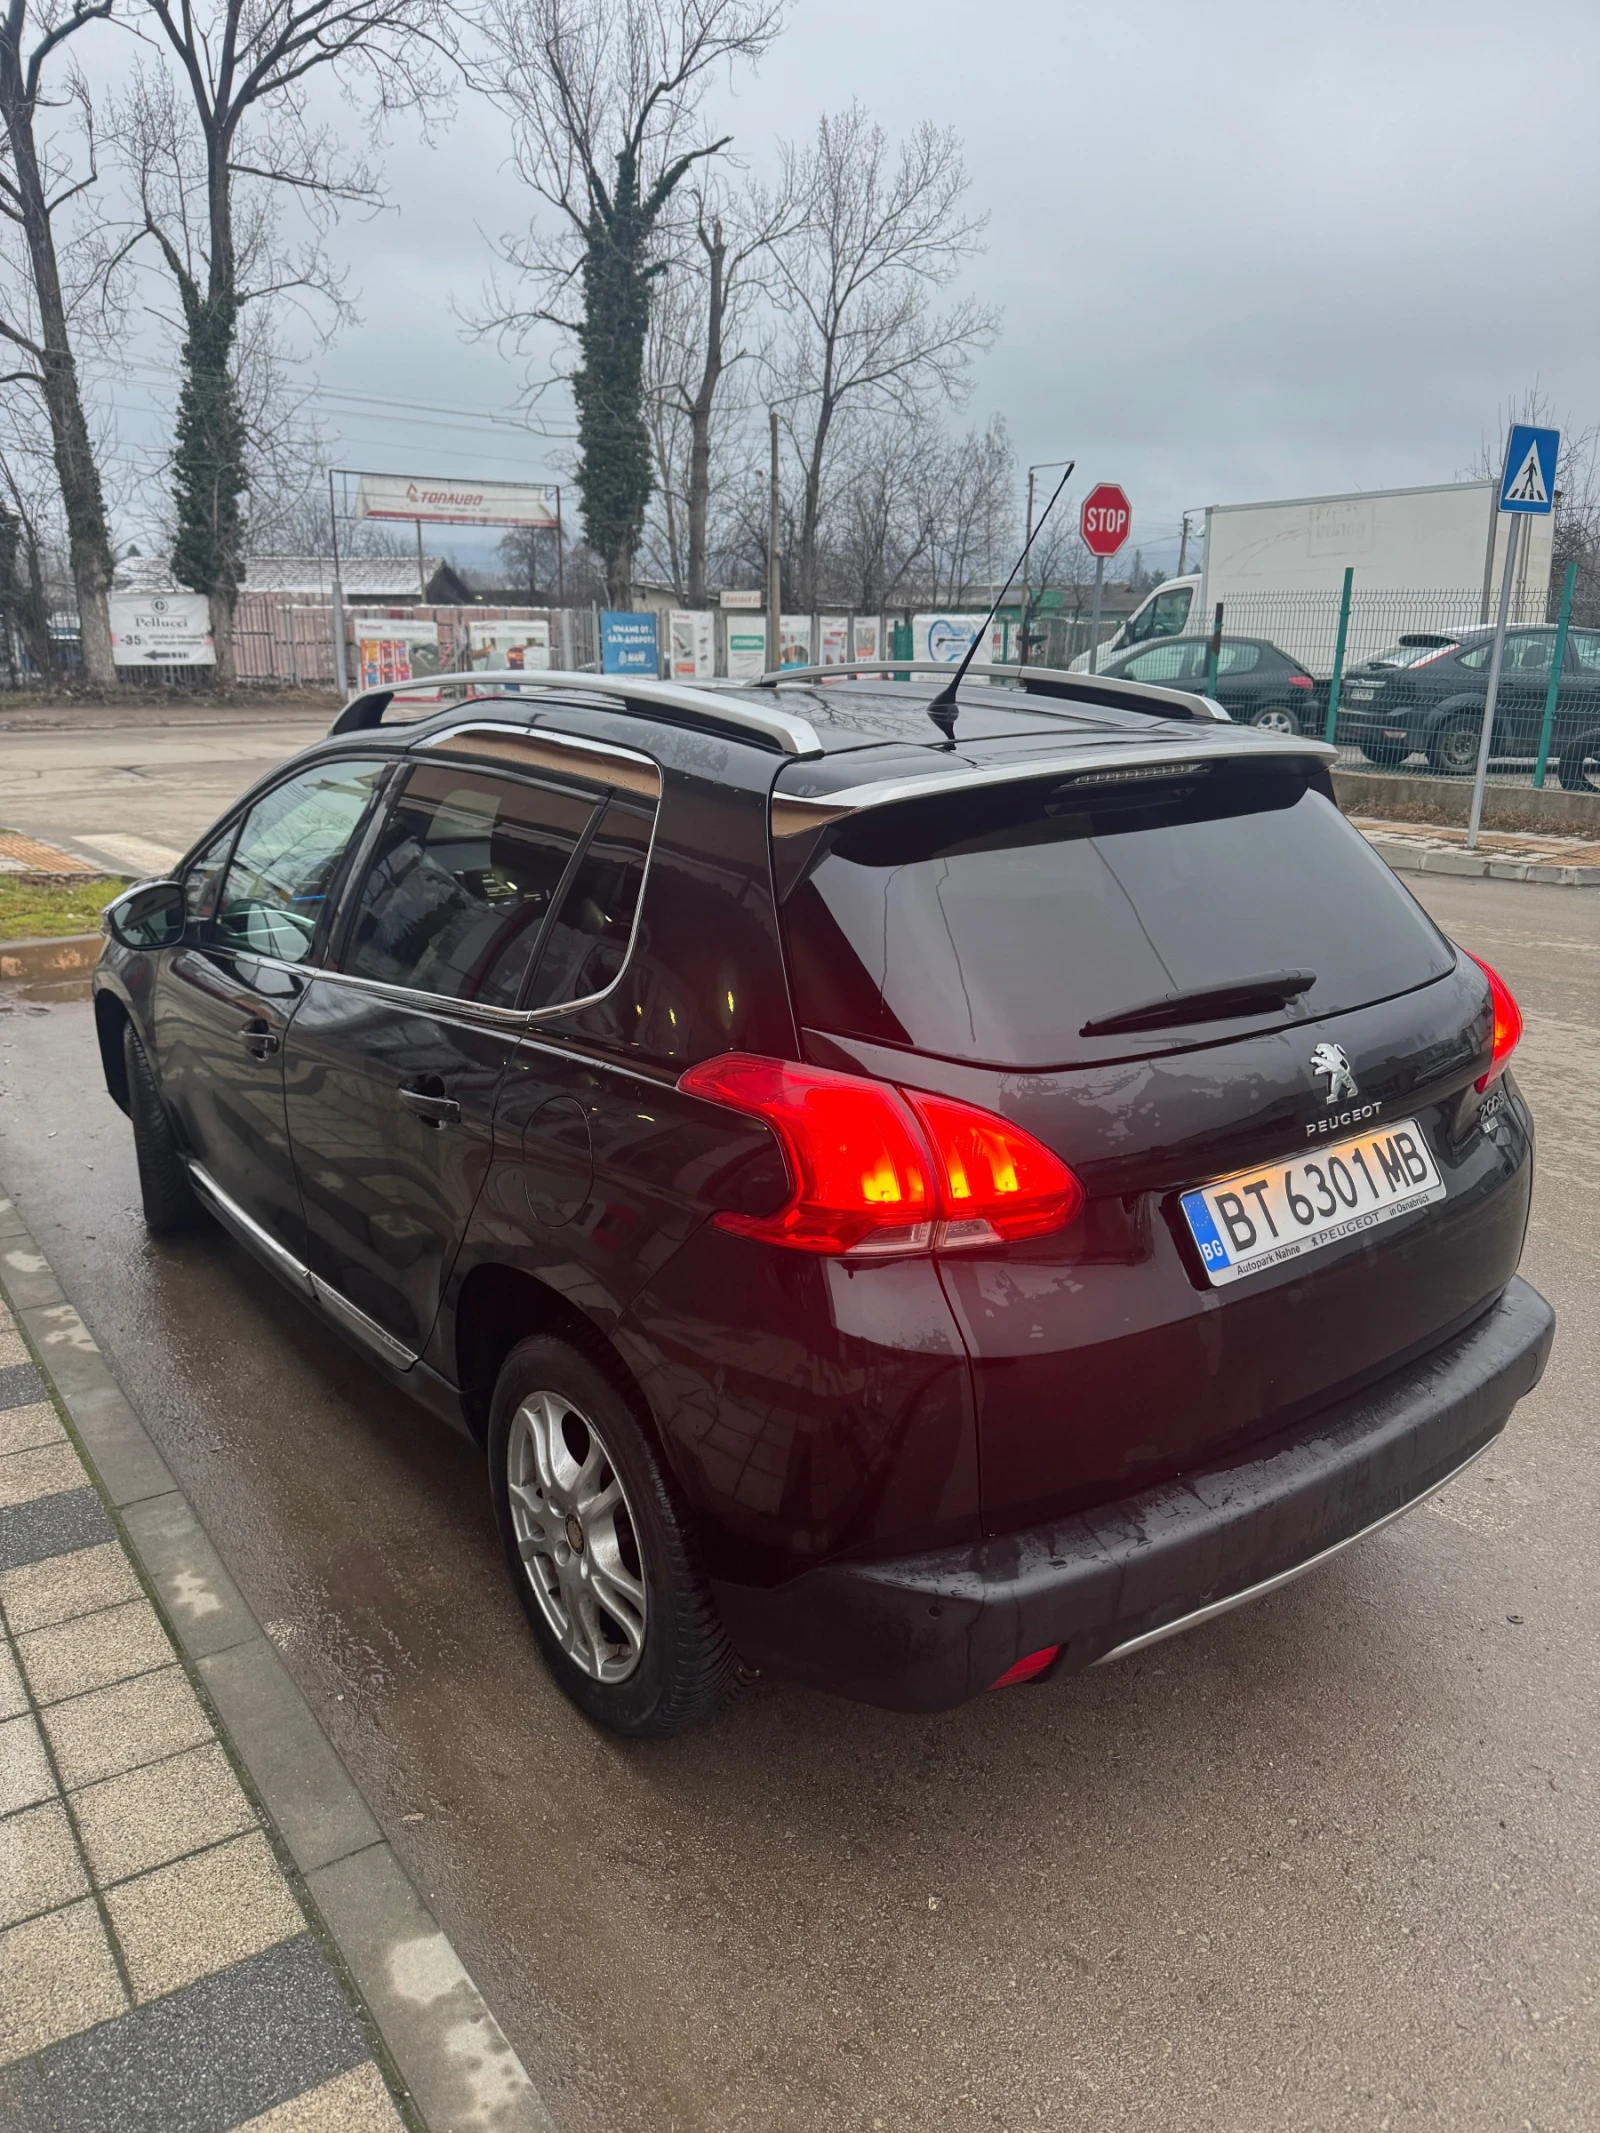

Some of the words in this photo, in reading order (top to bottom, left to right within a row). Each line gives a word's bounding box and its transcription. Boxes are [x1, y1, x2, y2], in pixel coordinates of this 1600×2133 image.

[1087, 507, 1126, 533] STOP
[136, 617, 188, 628] Pellucci
[1306, 1101, 1382, 1137] PEUGEOT
[1214, 1179, 1279, 1252] BT
[1285, 1148, 1380, 1226] 6301
[1372, 1132, 1428, 1194] MB
[1237, 1253, 1274, 1275] Autopark
[1275, 1244, 1300, 1261] Nahne
[1319, 1212, 1380, 1244] PEUGEOT
[1389, 1207, 1397, 1216] in
[1397, 1193, 1430, 1213] Osnabrück
[1201, 1239, 1224, 1262] BG
